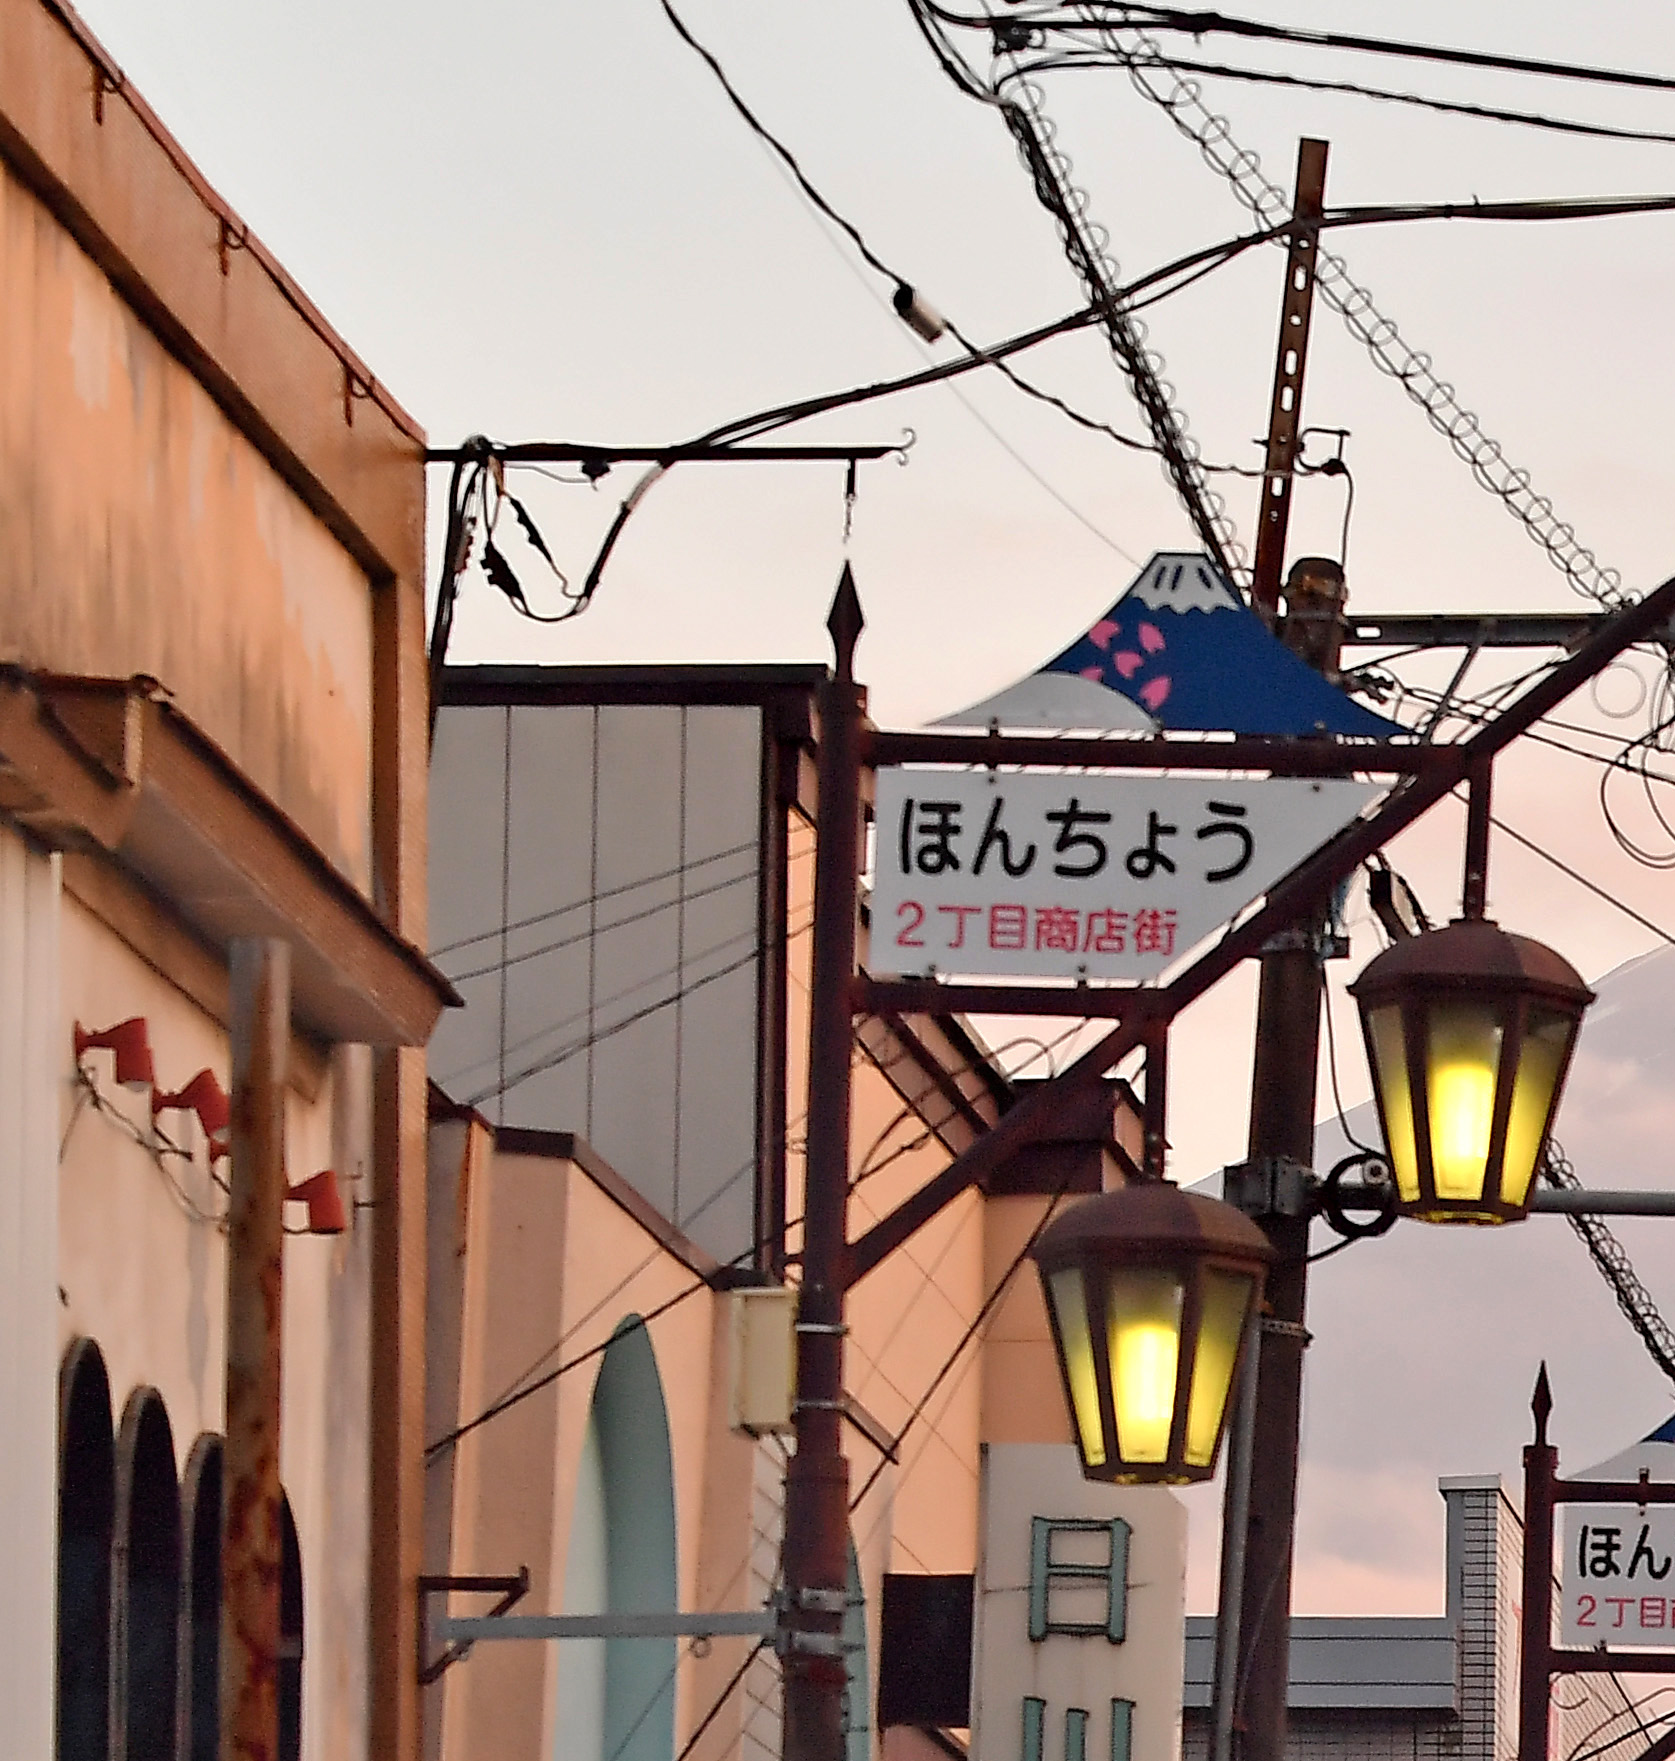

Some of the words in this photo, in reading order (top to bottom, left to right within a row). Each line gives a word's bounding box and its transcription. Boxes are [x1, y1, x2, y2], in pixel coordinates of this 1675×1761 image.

[899, 798, 1254, 881] ほんちょう
[895, 902, 1179, 956] 2丁目商店街
